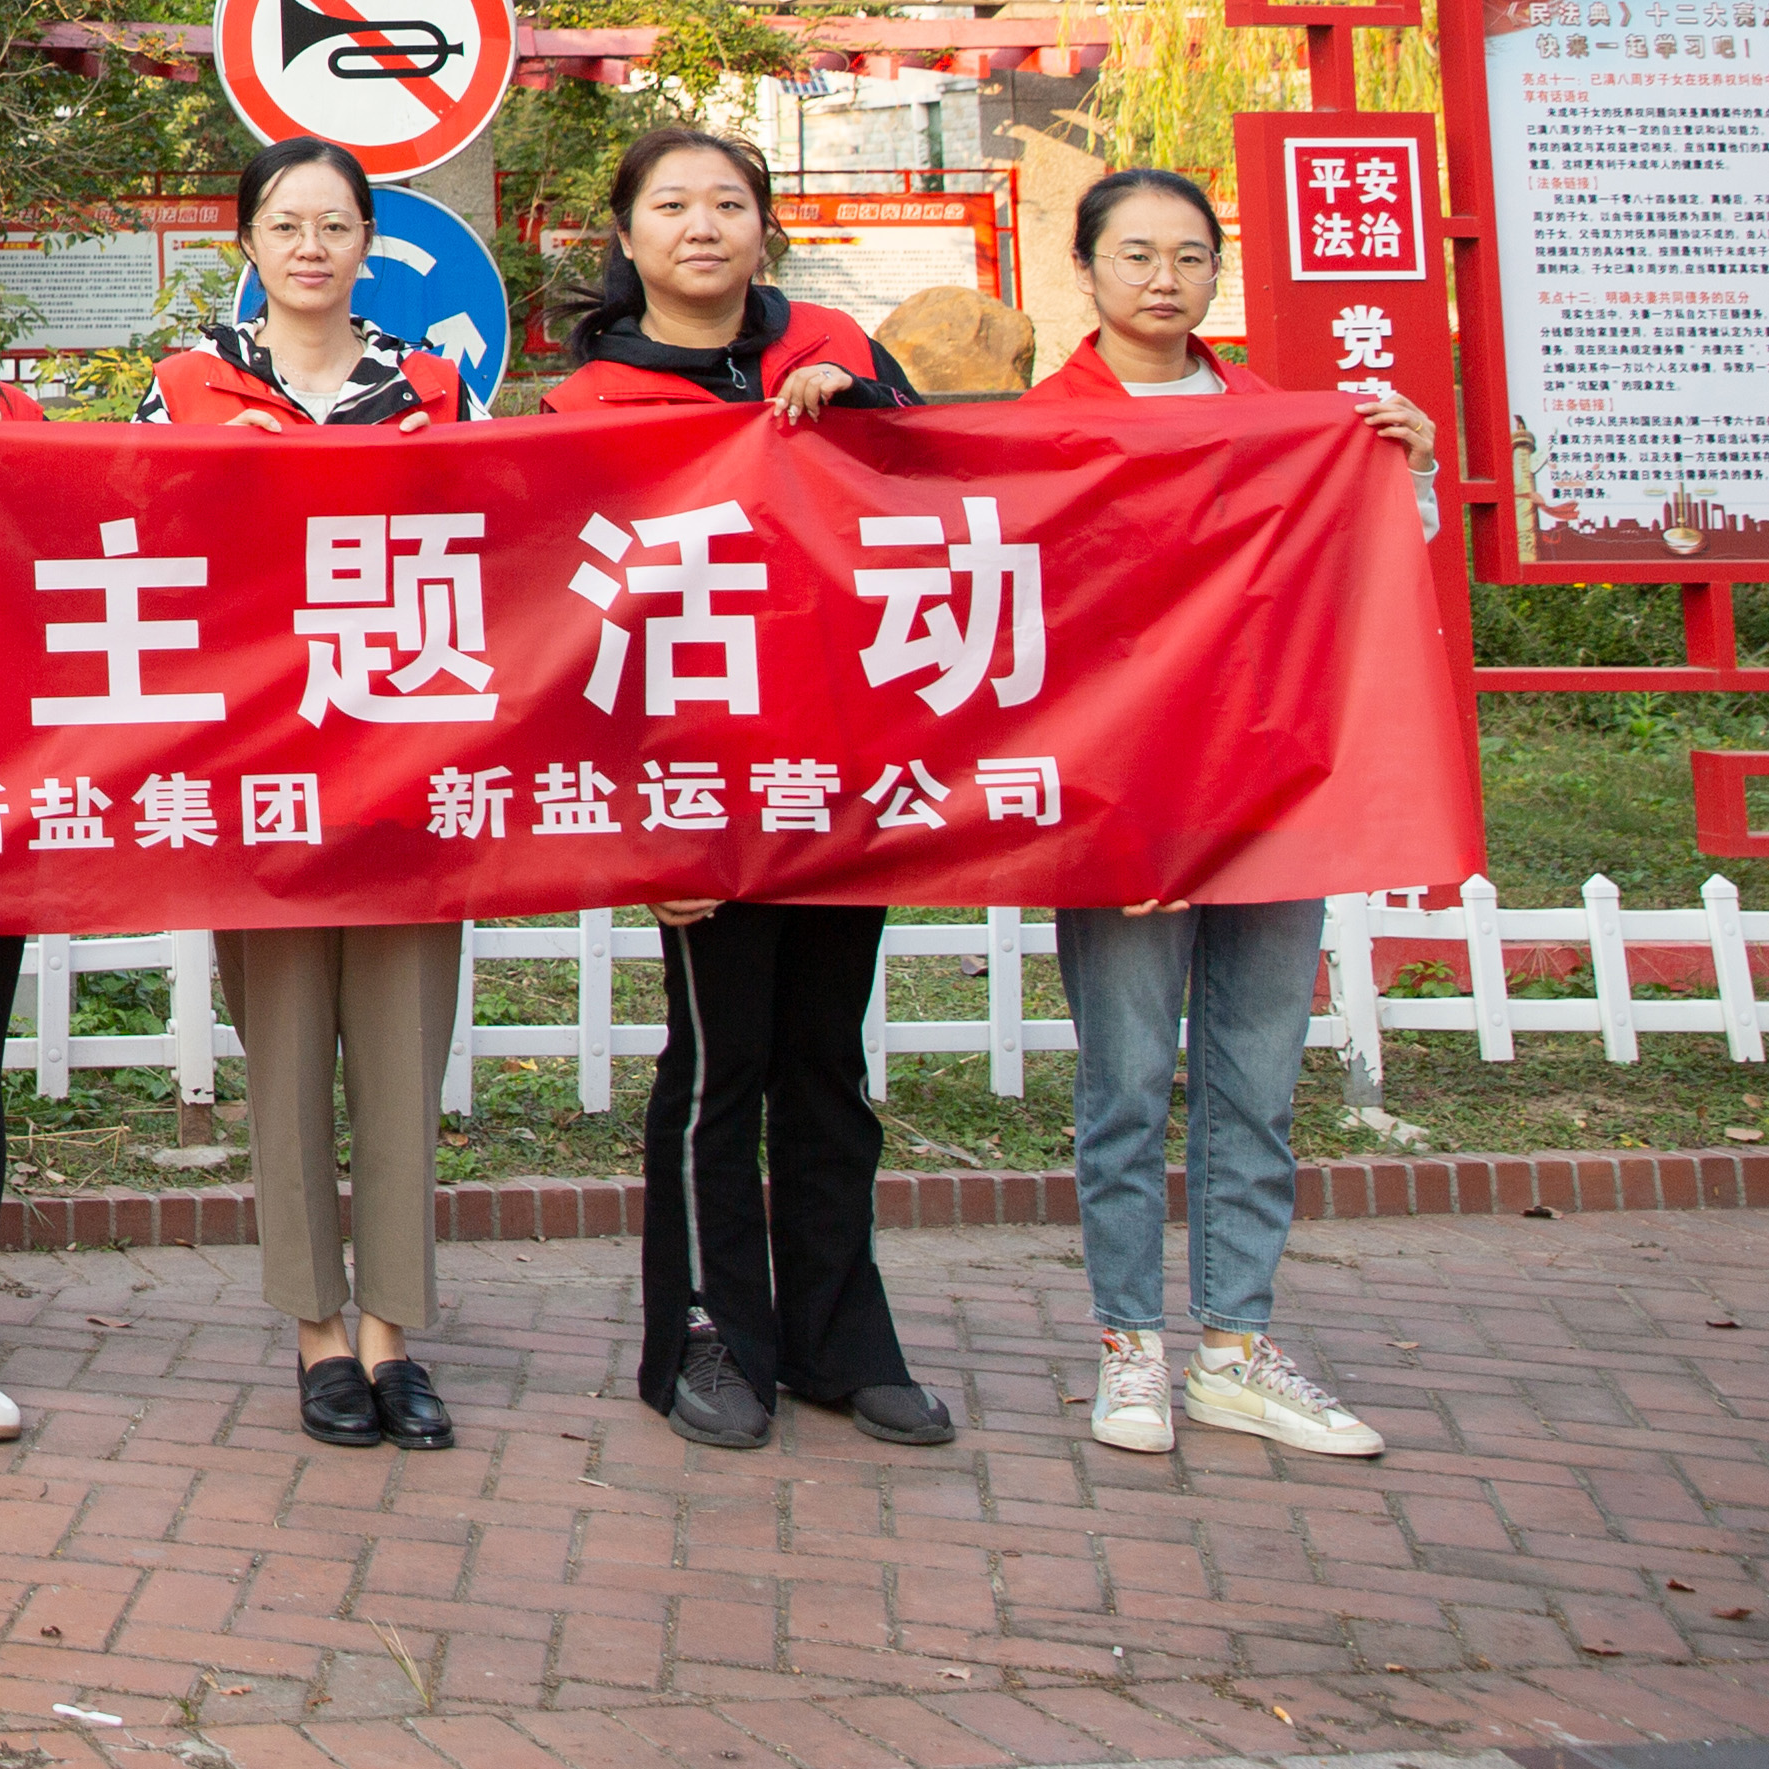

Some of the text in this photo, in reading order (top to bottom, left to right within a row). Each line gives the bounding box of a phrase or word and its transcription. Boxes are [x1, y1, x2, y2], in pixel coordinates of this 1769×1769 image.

[1523, 90, 1590, 104] 享有话语权
[1309, 157, 1398, 204] 平安
[1311, 212, 1402, 258] 法治
[427, 755, 1063, 840] 新盐运营公司
